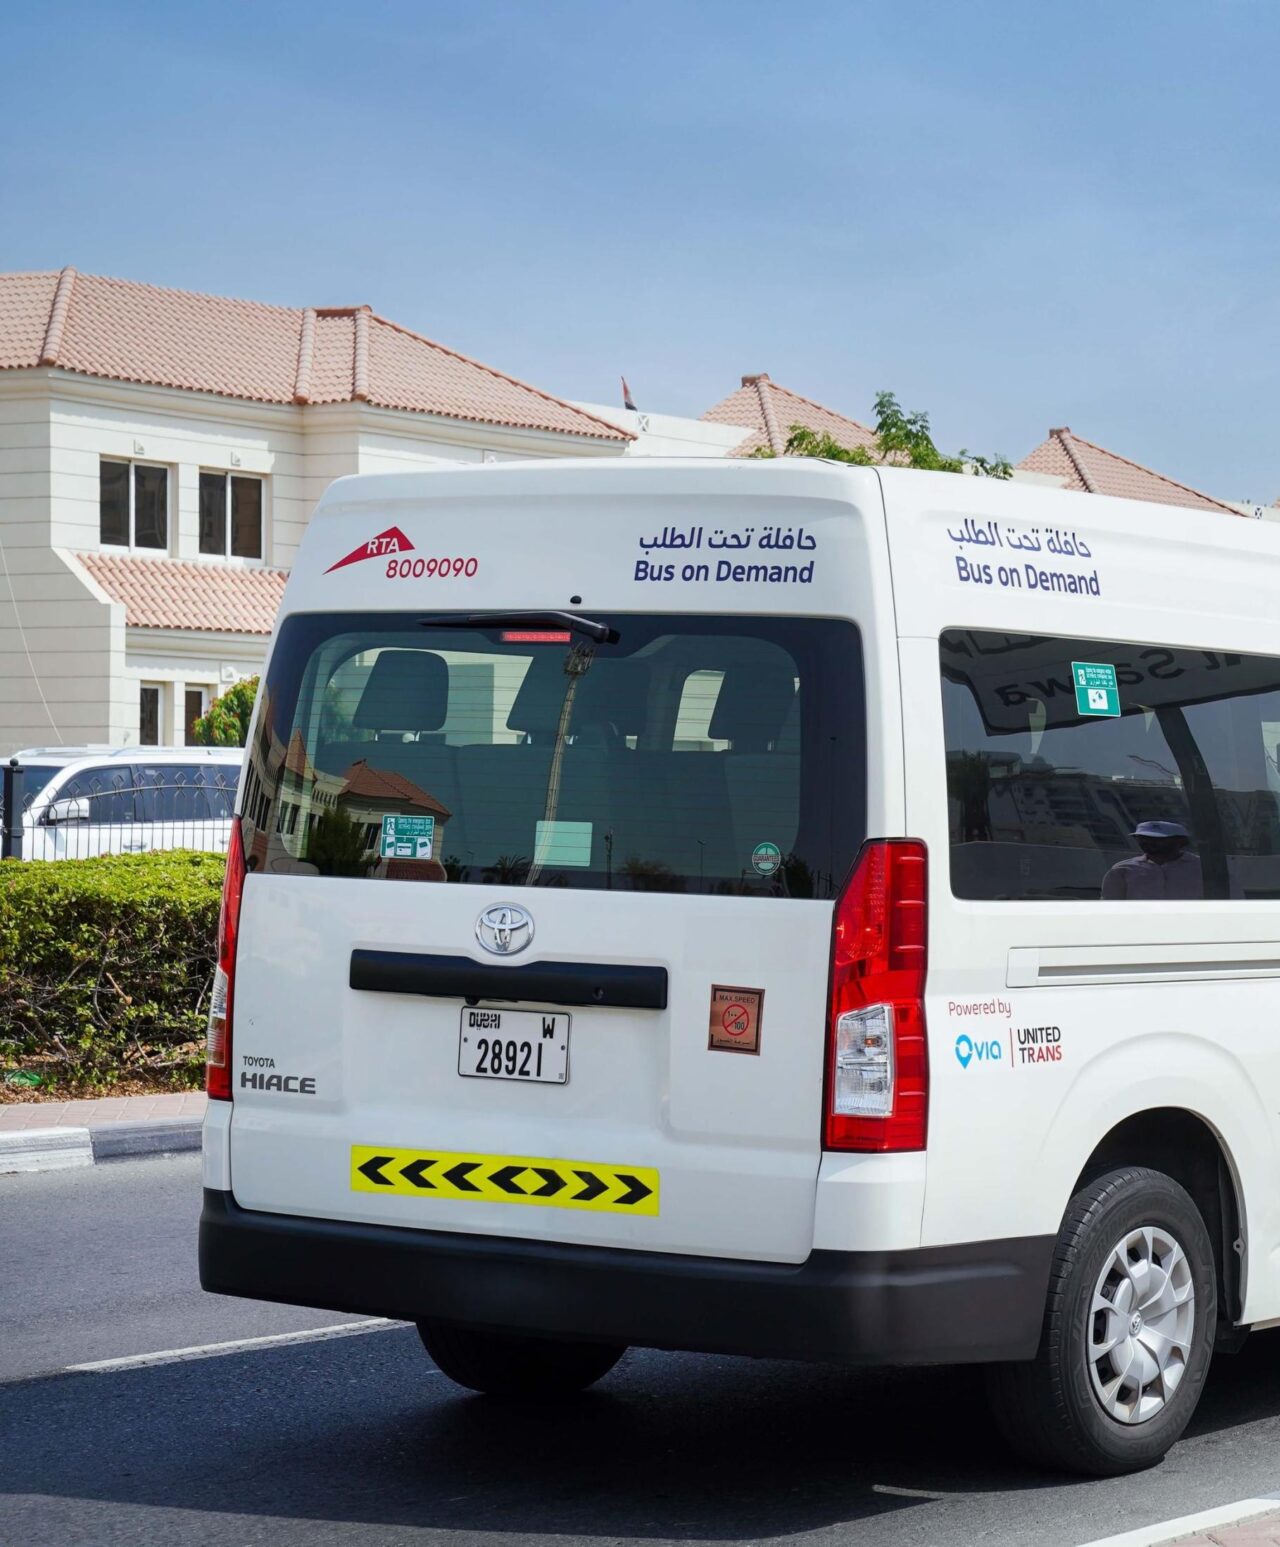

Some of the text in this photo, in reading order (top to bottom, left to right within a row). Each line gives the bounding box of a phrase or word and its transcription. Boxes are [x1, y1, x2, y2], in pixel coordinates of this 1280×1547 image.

[367, 537, 400, 554] RTA
[639, 526, 817, 556] حافلة تحت الطلب
[947, 518, 1092, 558] حافلة تحت الطلب
[385, 557, 479, 579] 8009090
[633, 560, 815, 584] Bus on Demand
[955, 555, 1101, 597] Bus on Demand
[948, 998, 1012, 1019] Powered by
[542, 1016, 556, 1039] W
[734, 1021, 745, 1030] 100
[1017, 1026, 1061, 1045] UNITED
[242, 1055, 275, 1069] TOYOTA
[475, 1038, 543, 1077] 28921
[1018, 1045, 1063, 1064] TRANS
[240, 1071, 316, 1095] HIACE
